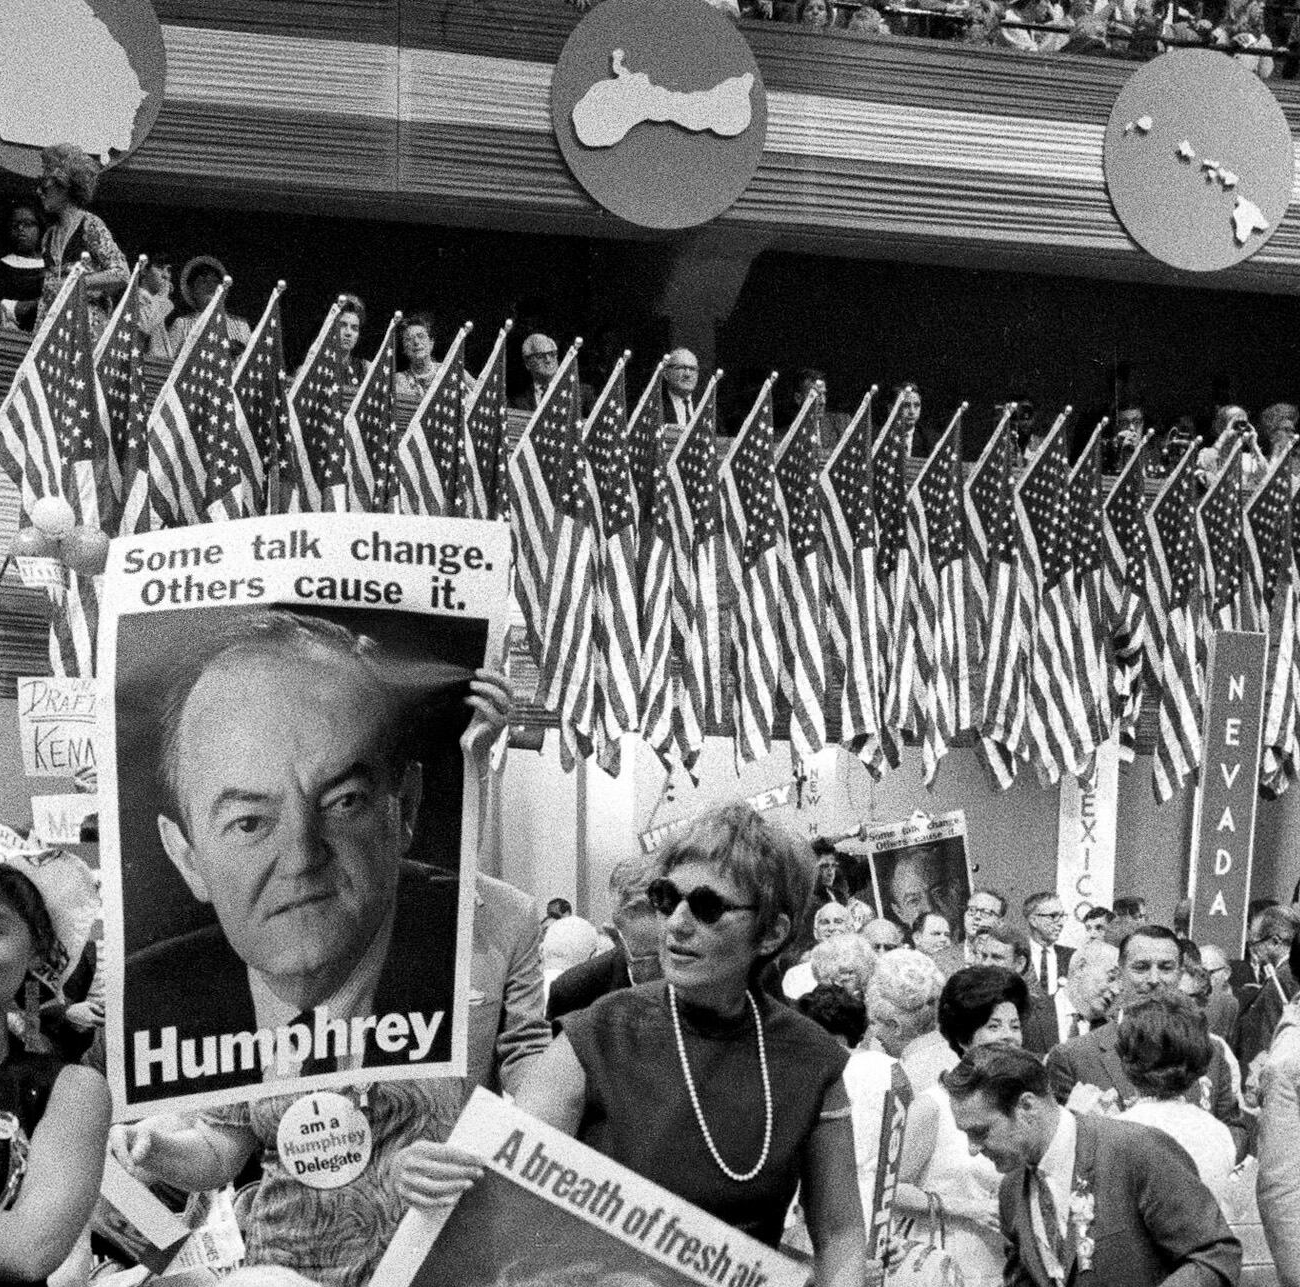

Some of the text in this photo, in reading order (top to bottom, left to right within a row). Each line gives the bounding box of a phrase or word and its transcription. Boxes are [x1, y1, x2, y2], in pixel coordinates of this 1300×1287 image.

[123, 531, 494, 575] Some talk change.
[140, 572, 467, 611] Others cause it.
[1208, 675, 1246, 916] NEVADA
[1074, 770, 1099, 922] EXICO
[134, 1008, 444, 1086] Humphrey
[300, 1116, 340, 1136] am a
[312, 1100, 320, 1116] I
[283, 1129, 367, 1157] Humphrey
[294, 1151, 363, 1175] Delegate
[492, 1128, 527, 1171] A
[520, 1140, 627, 1223] breath
[622, 1199, 664, 1238] of
[656, 1216, 733, 1280] fresh
